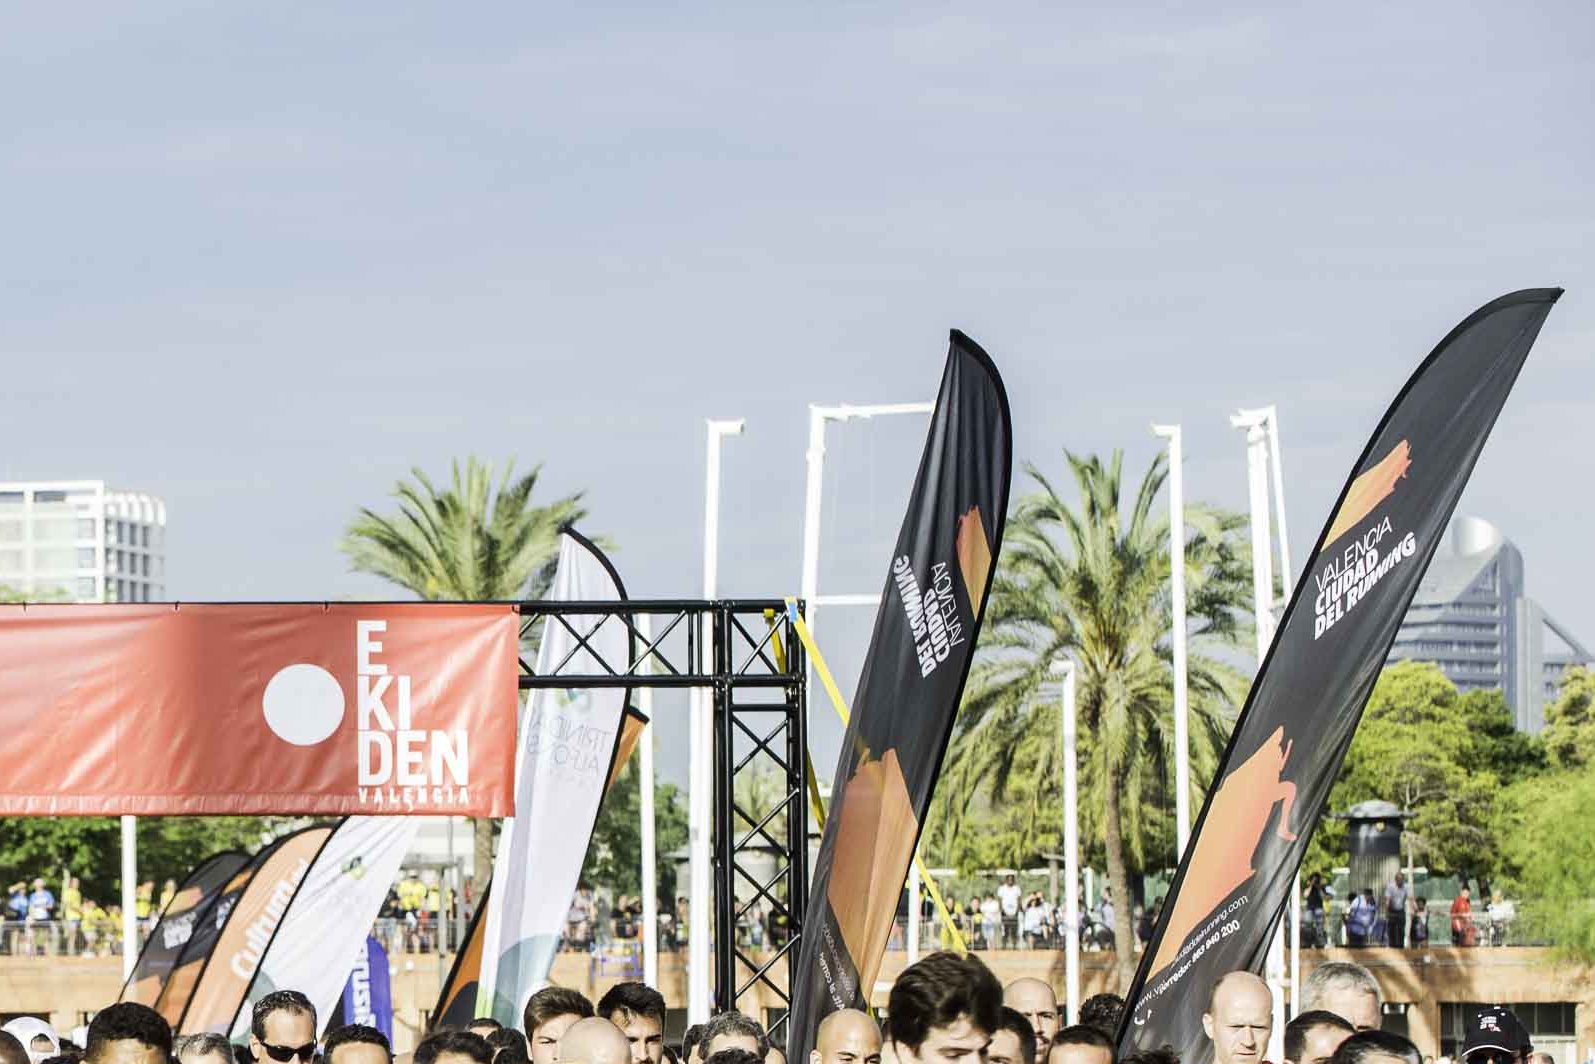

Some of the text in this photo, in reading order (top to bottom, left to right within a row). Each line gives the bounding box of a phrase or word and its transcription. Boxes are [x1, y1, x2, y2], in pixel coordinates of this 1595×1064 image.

[1314, 548, 1379, 616] CIUDAD
[1316, 516, 1393, 592] VALENCIA
[1314, 598, 1344, 640] DEL
[357, 674, 412, 730] KI
[358, 730, 469, 786] DEN
[358, 787, 470, 805] VALENCIA
[1220, 919, 1240, 938] 200
